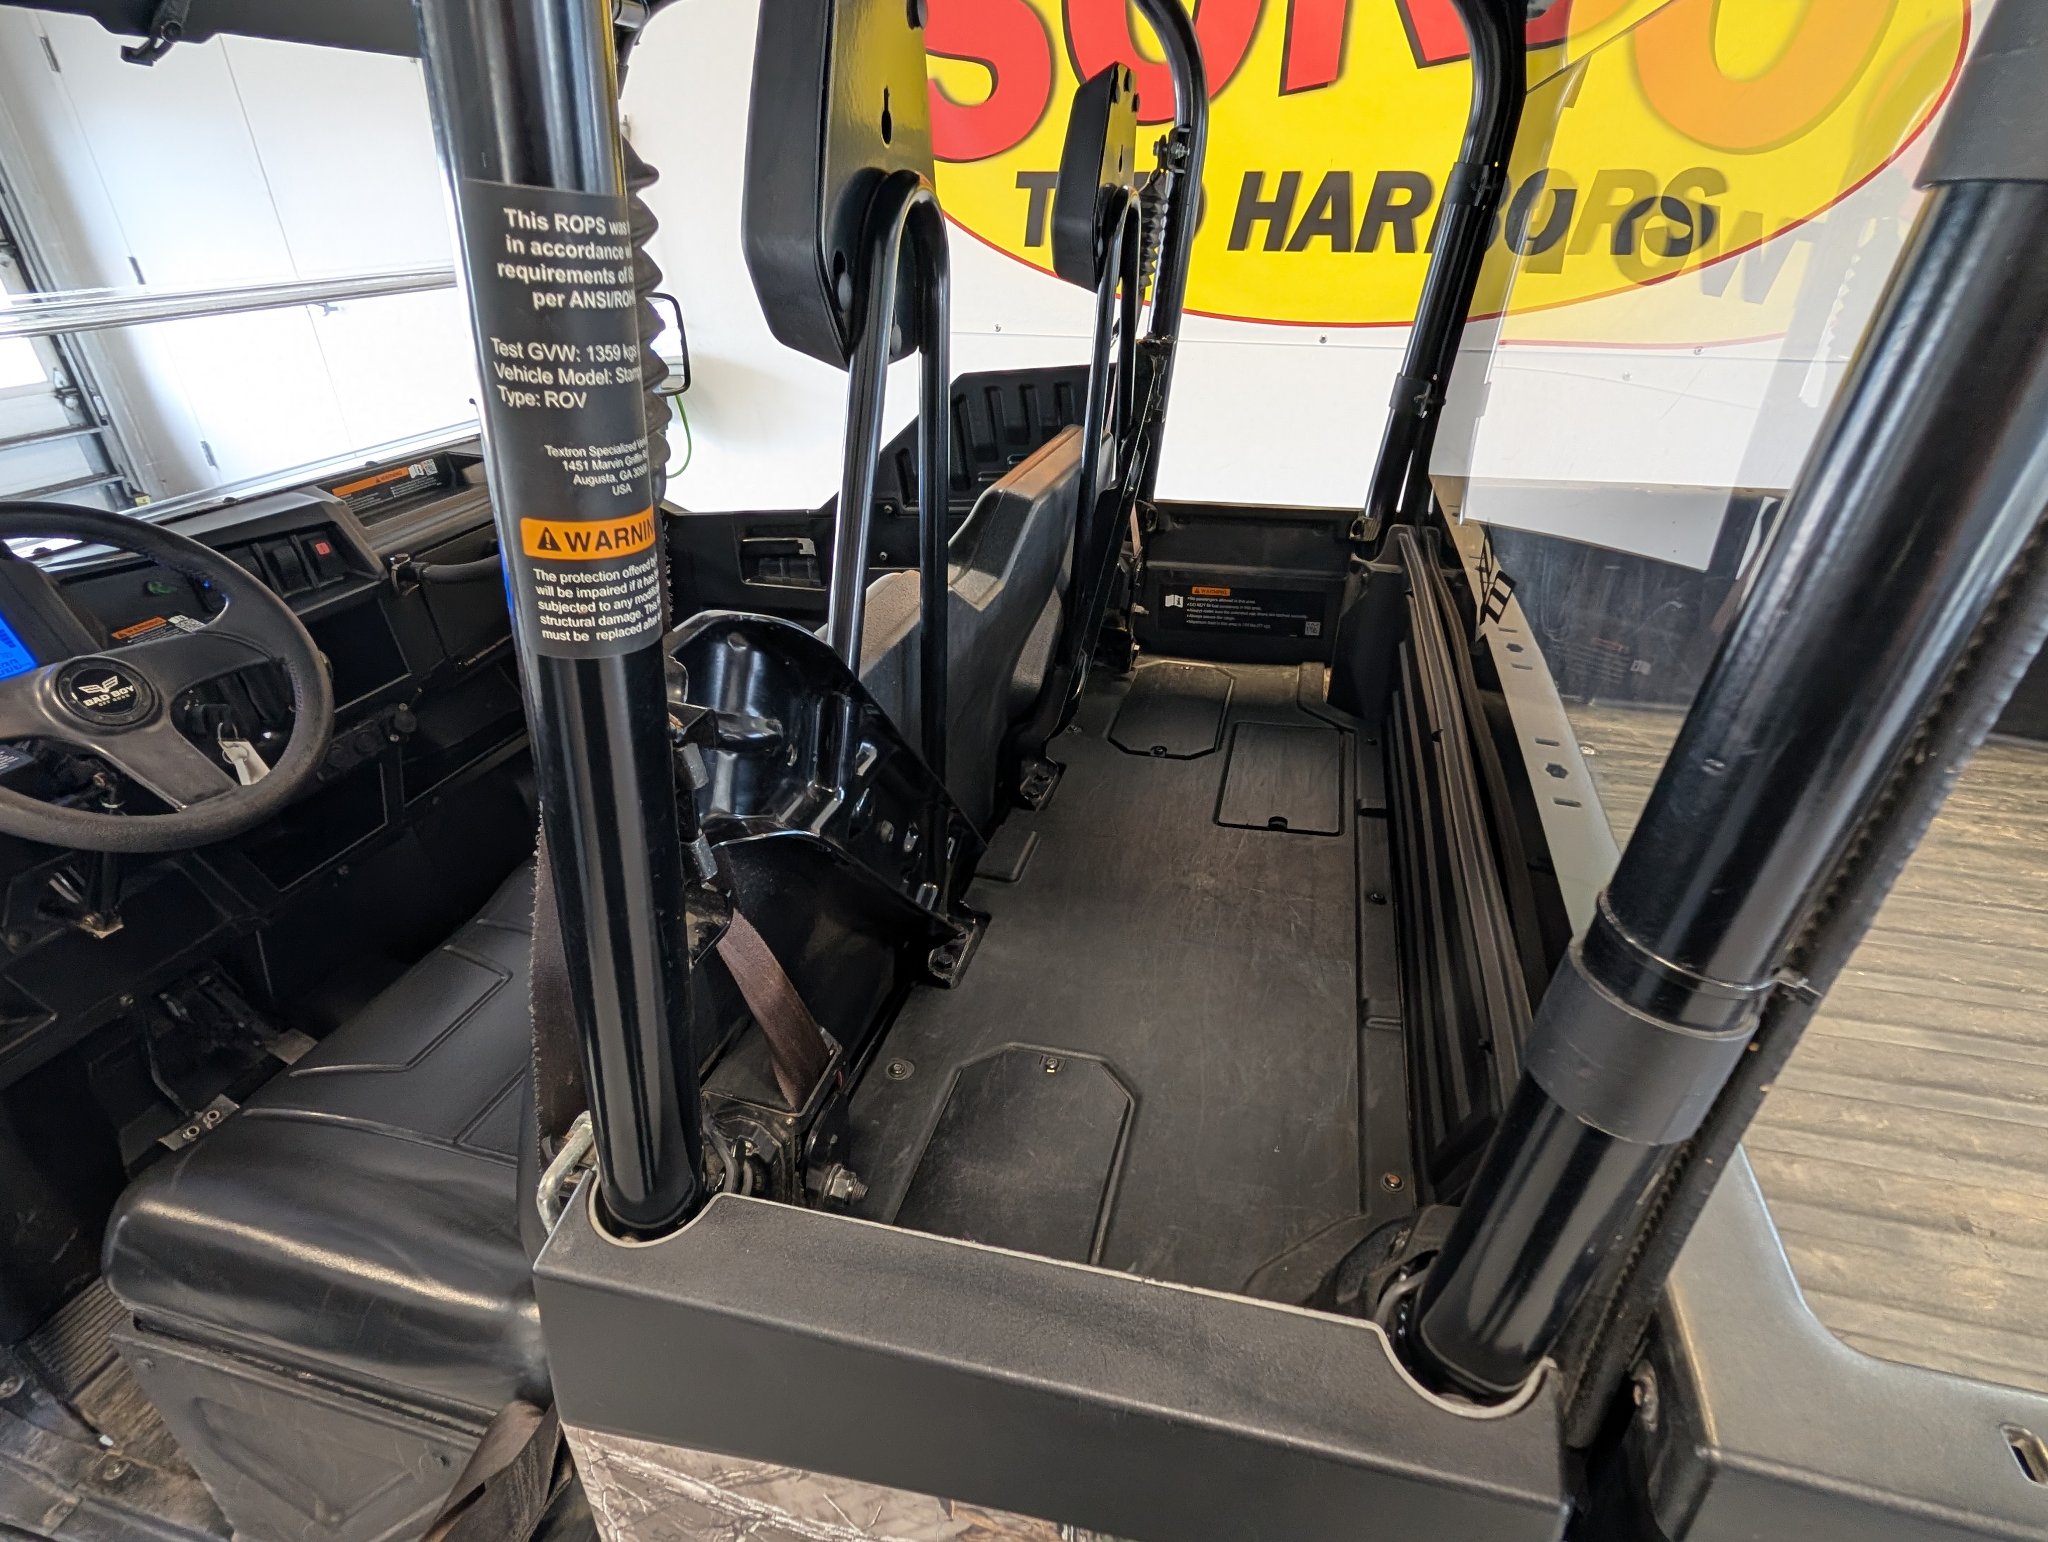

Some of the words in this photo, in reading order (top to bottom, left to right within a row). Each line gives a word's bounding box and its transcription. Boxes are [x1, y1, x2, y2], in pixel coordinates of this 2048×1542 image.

[503, 208, 549, 231] This
[554, 213, 606, 236] ROPS
[609, 221, 628, 236] was
[505, 234, 525, 254] in
[530, 240, 625, 260] accordance
[496, 262, 616, 285] requirements
[532, 290, 565, 310] per
[490, 337, 524, 359] Test
[528, 342, 581, 362] GVW:
[586, 344, 621, 362] 1359
[493, 361, 553, 385] Vehicle
[558, 368, 613, 386] Model:
[497, 385, 541, 408] Type:
[544, 390, 587, 409] ROV
[543, 444, 587, 458] Textron
[562, 460, 589, 471] 1451
[591, 458, 624, 471] Marvin
[573, 473, 618, 487] Augusta,
[612, 483, 632, 496] USA
[564, 518, 654, 552] WARNIN
[533, 568, 557, 583] The
[560, 570, 621, 585] protection
[535, 585, 554, 598] will
[557, 585, 574, 599] be
[576, 581, 627, 600] impaired
[538, 600, 596, 615] subjected
[599, 600, 611, 612] to
[613, 598, 633, 610] any
[540, 614, 596, 628] structural
[598, 609, 644, 626] damage.
[542, 630, 570, 642] must
[573, 630, 590, 642] be
[596, 622, 642, 642] replaced
[111, 685, 134, 697] BOY
